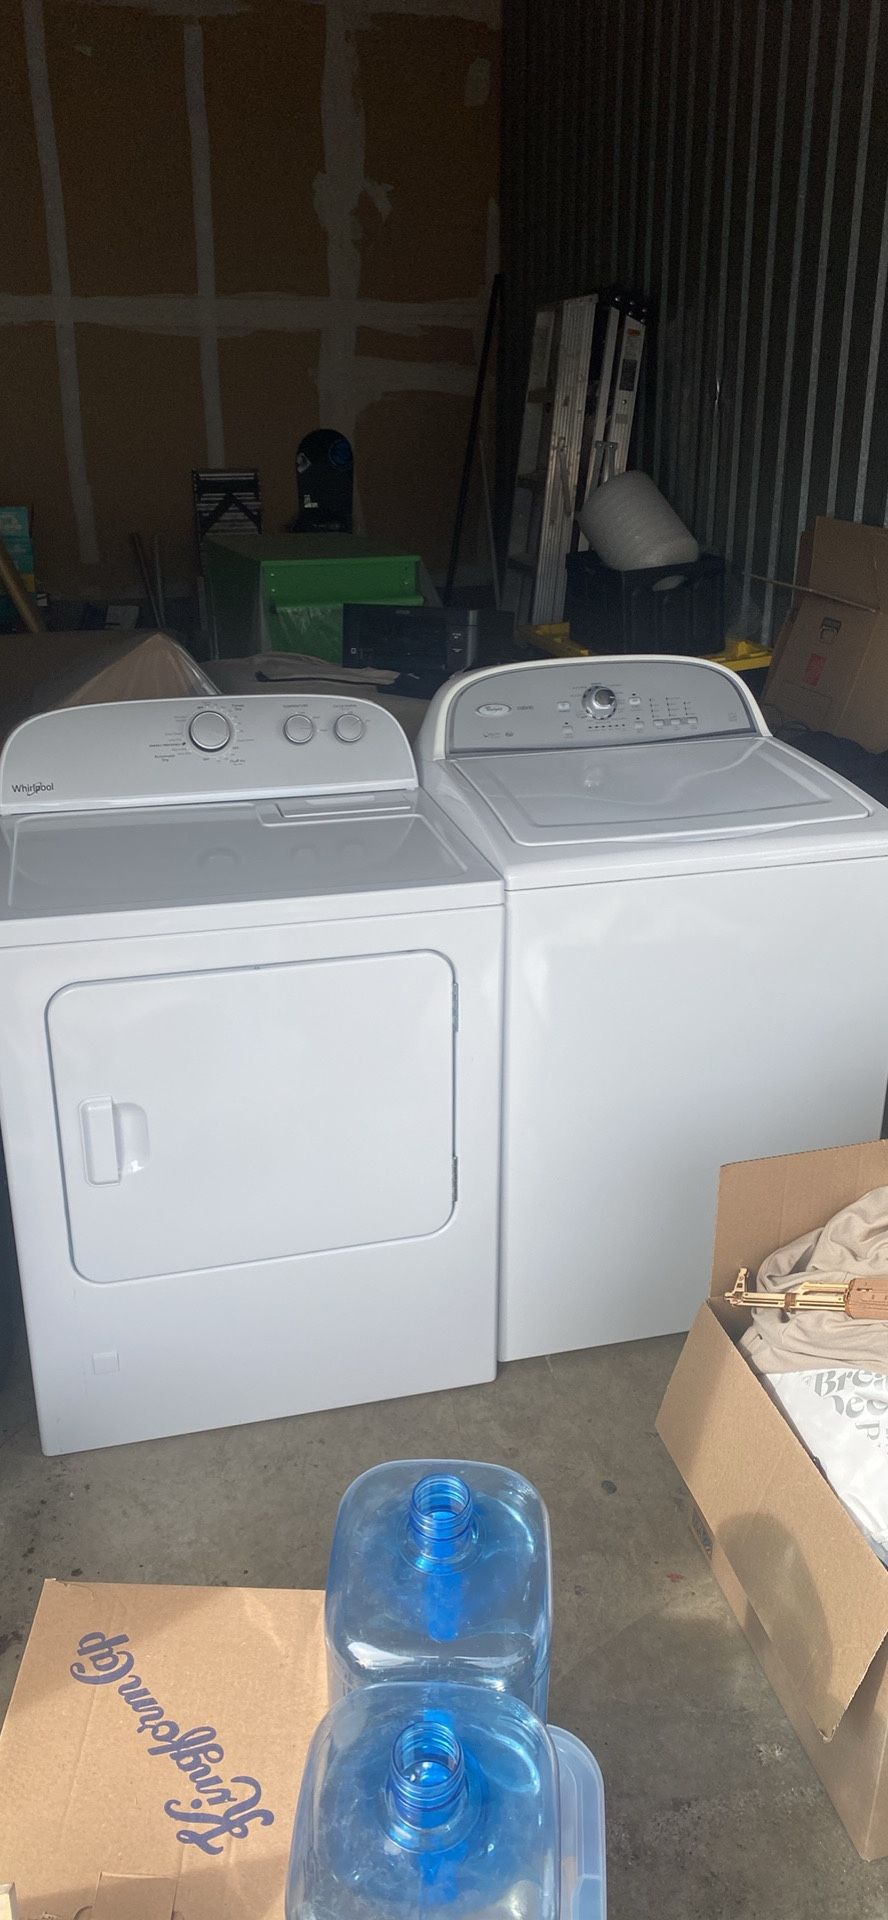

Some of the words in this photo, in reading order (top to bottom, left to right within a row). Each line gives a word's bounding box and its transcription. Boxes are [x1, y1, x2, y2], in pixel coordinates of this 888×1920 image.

[12, 782, 54, 796] Whirlpool
[70, 1631, 135, 1685] Cap
[118, 1675, 274, 1855] Kingform
